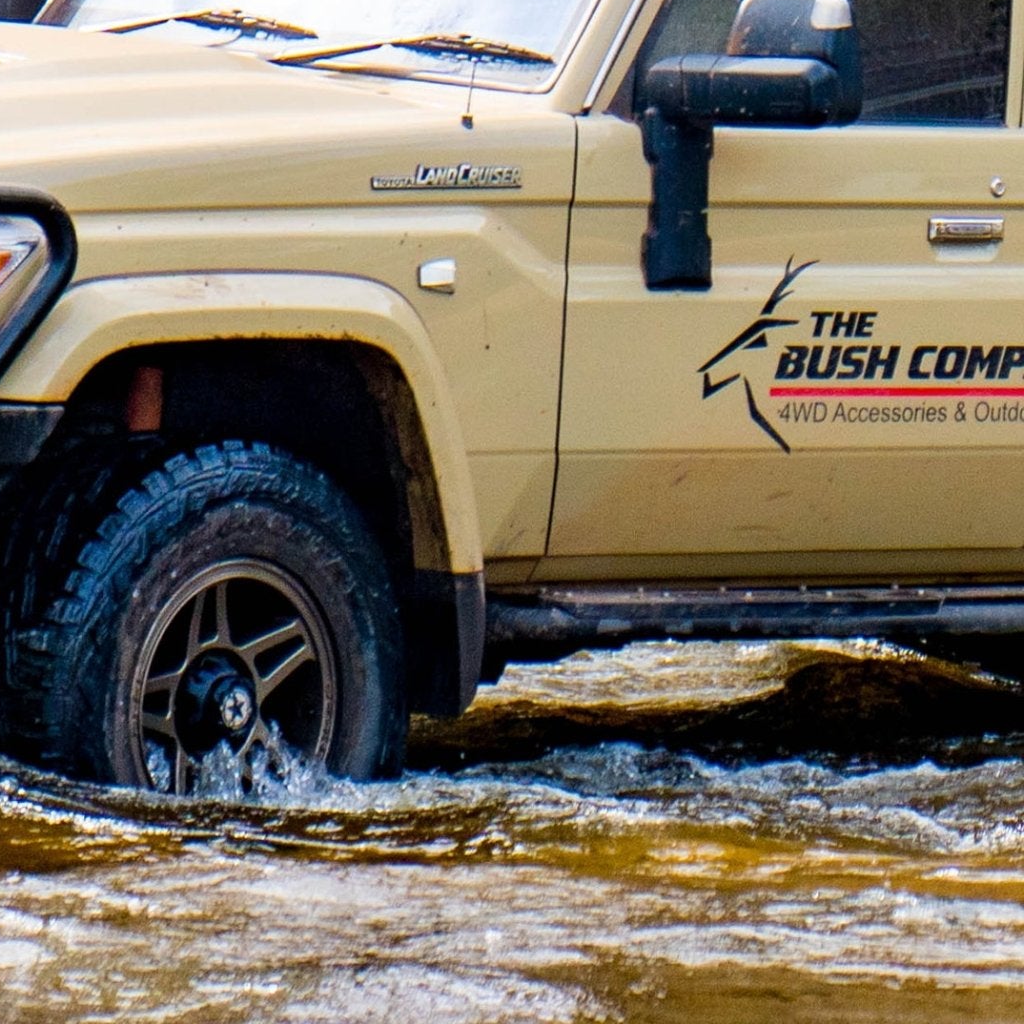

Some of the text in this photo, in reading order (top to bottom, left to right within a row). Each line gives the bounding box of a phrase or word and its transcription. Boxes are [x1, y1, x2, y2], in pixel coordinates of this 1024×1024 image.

[811, 311, 878, 338] THE
[774, 345, 1024, 380] BUSH COMP
[779, 402, 827, 423] 4WD
[833, 401, 948, 423] Accessories
[954, 401, 967, 423] &
